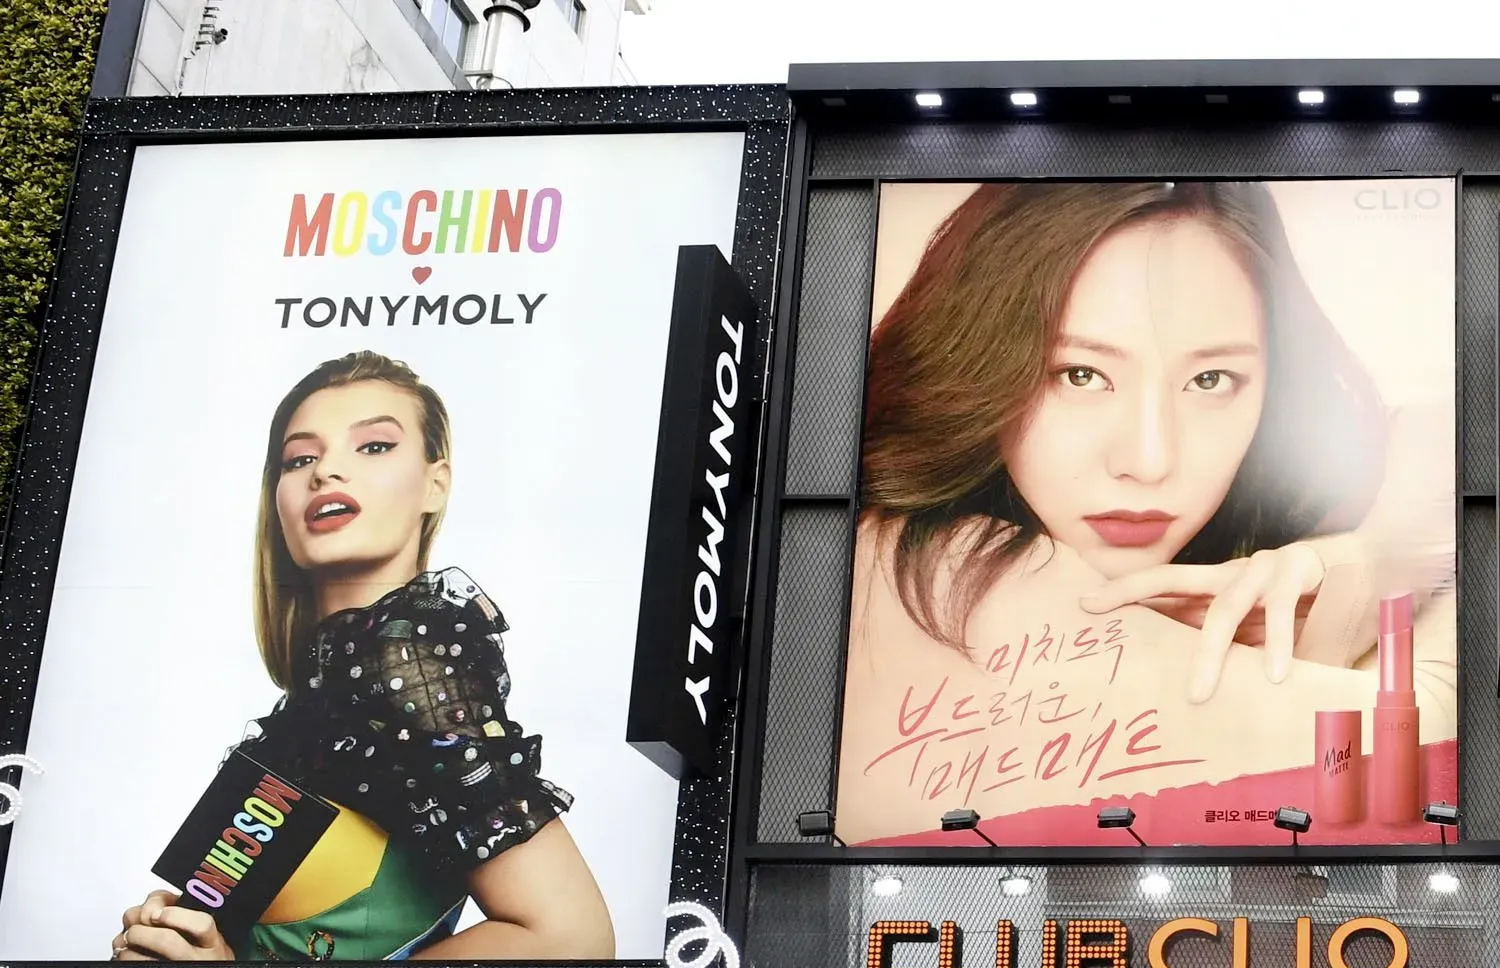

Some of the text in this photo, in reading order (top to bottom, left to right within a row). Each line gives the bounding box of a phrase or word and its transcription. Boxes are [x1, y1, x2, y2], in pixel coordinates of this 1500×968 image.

[1354, 188, 1441, 210] CLIO
[283, 187, 563, 258] MOSCHINO
[275, 293, 548, 329] TONYMOLY
[684, 314, 745, 726] TONYMOLY
[985, 619, 1130, 685] 미치도록
[1383, 721, 1410, 731] CLIO
[1323, 740, 1352, 771] Mad
[1205, 811, 1240, 822] 클리오
[186, 774, 303, 908] MOSCHINO
